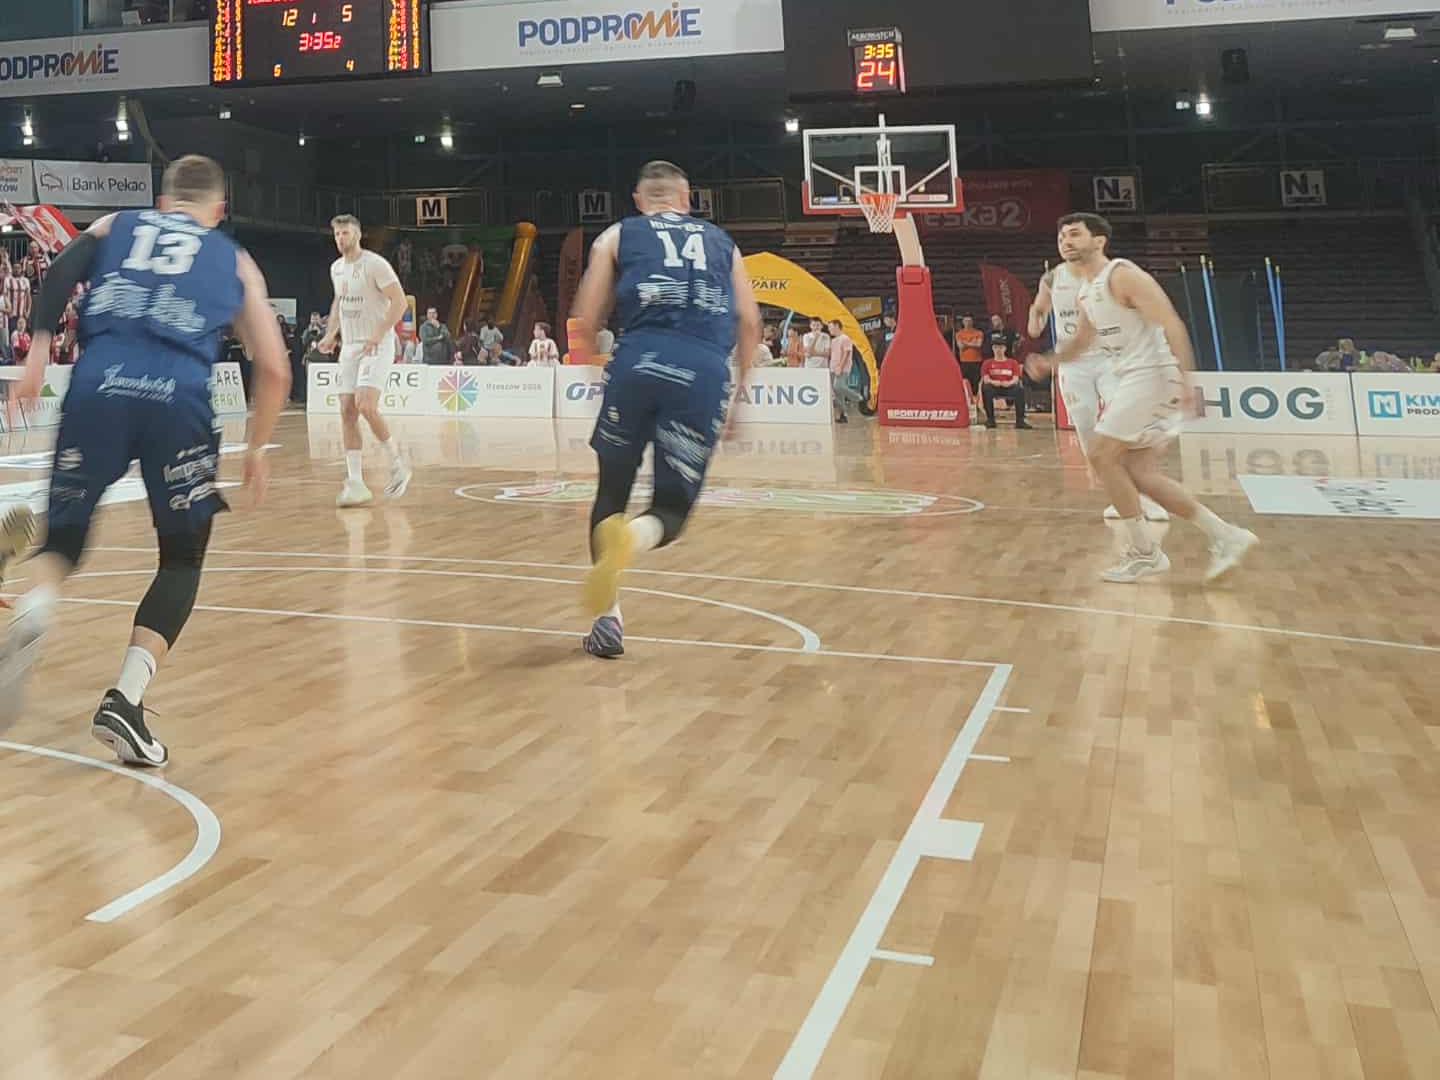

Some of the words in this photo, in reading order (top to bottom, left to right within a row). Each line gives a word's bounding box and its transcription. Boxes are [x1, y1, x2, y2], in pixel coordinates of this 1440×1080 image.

[282, 8, 298, 27] 12
[311, 12, 317, 24] 1
[342, 4, 353, 23] 5
[864, 43, 895, 60] 3:35
[346, 59, 355, 72] 4
[857, 61, 896, 88] 24
[71, 176, 105, 192] Bank
[109, 176, 147, 193] Pekao
[421, 199, 442, 218] M
[121, 225, 202, 275] 13
[656, 231, 707, 271] 14
